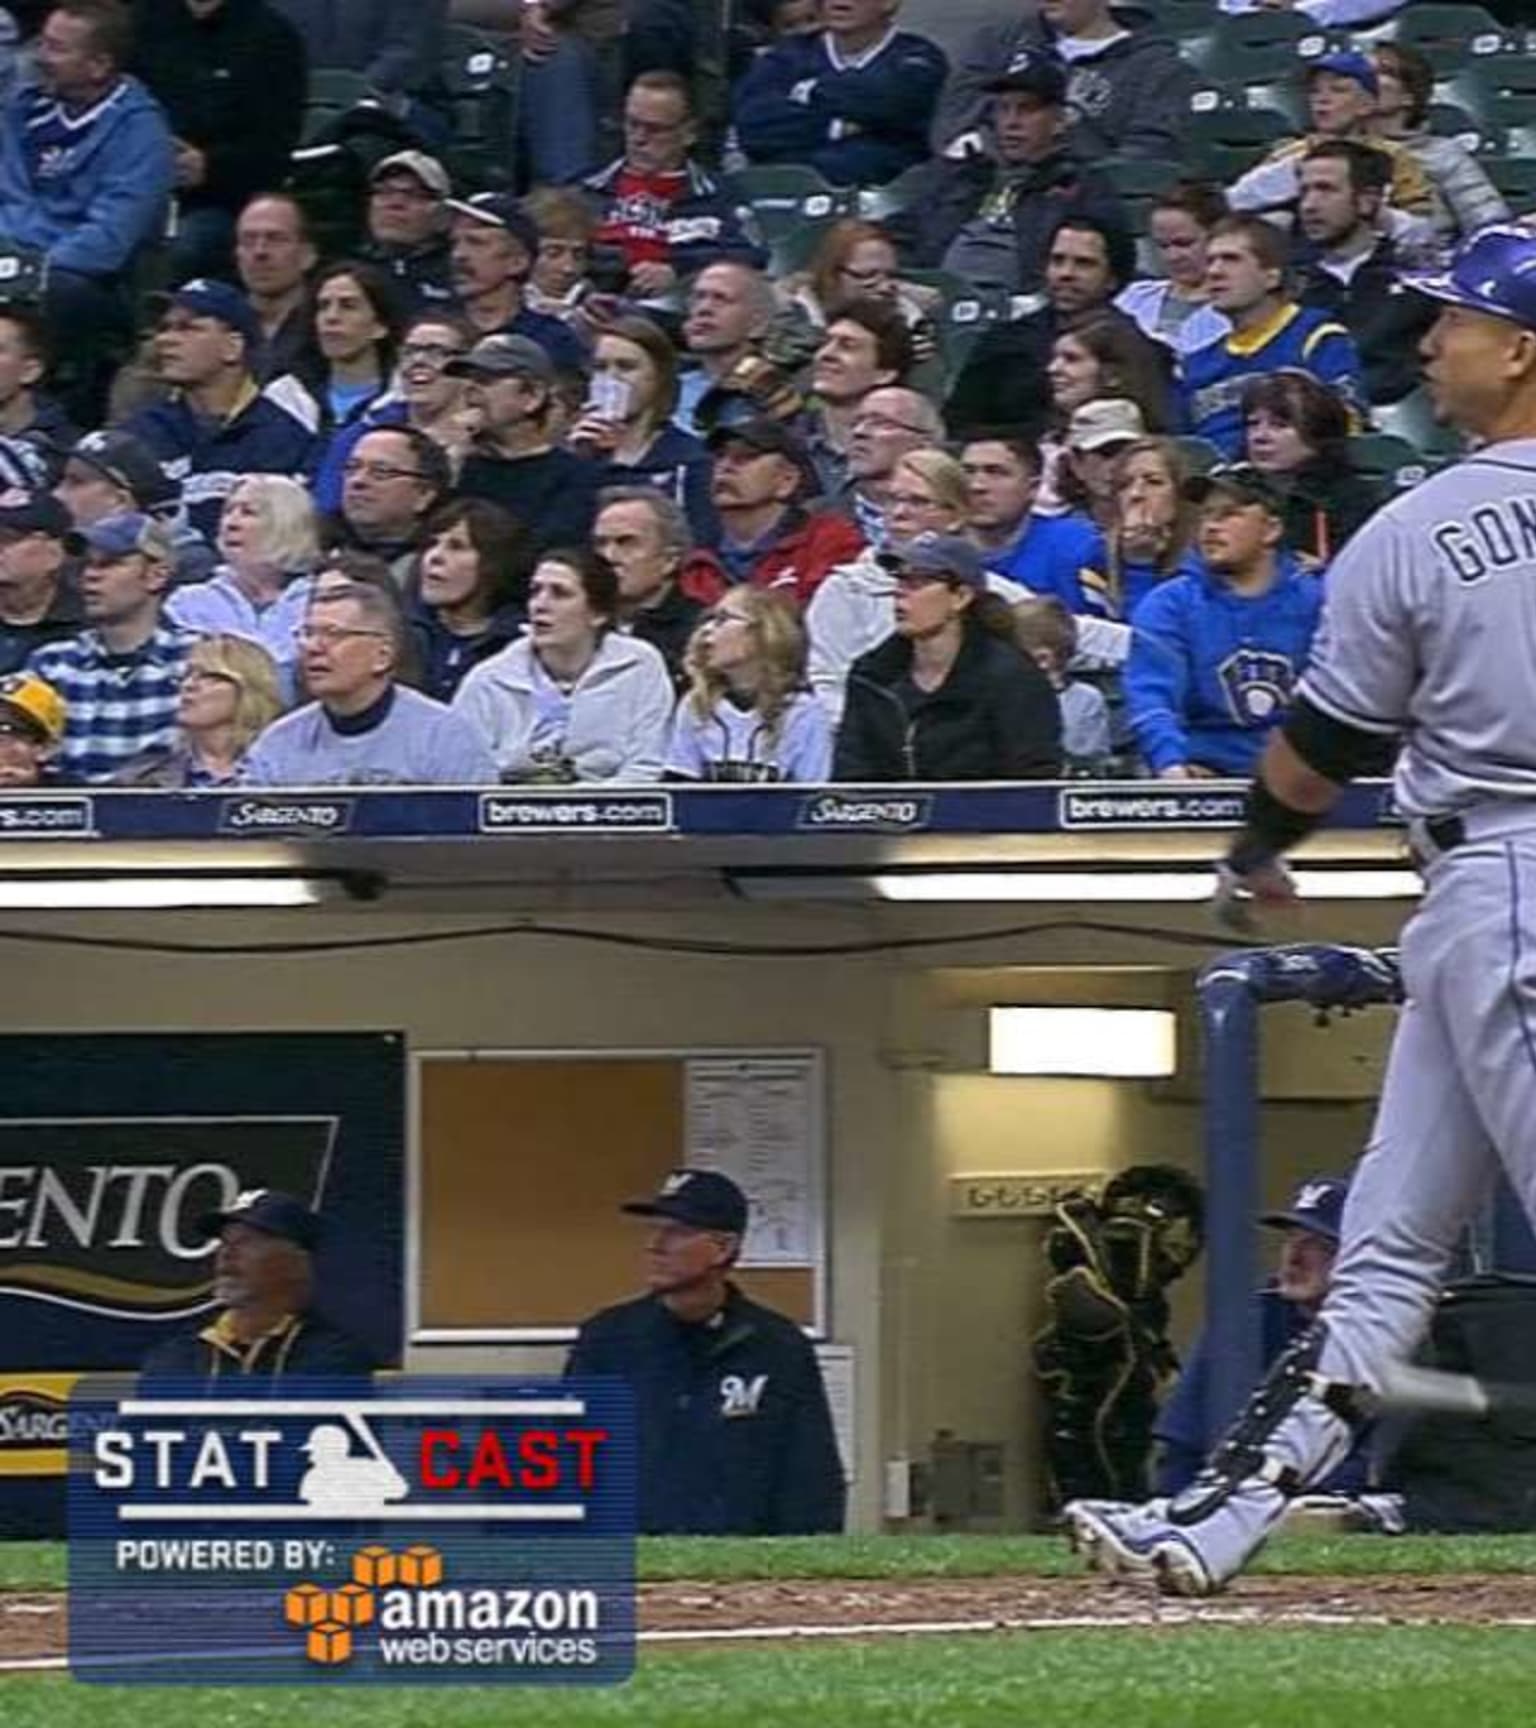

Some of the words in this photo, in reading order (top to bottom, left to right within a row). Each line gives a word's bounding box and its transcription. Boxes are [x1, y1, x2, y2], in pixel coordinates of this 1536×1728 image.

[488, 801, 663, 823] brewers.com
[811, 799, 917, 823] SARGENTO
[1069, 798, 1245, 818] brewers.com
[0, 1163, 240, 1259] ENTO
